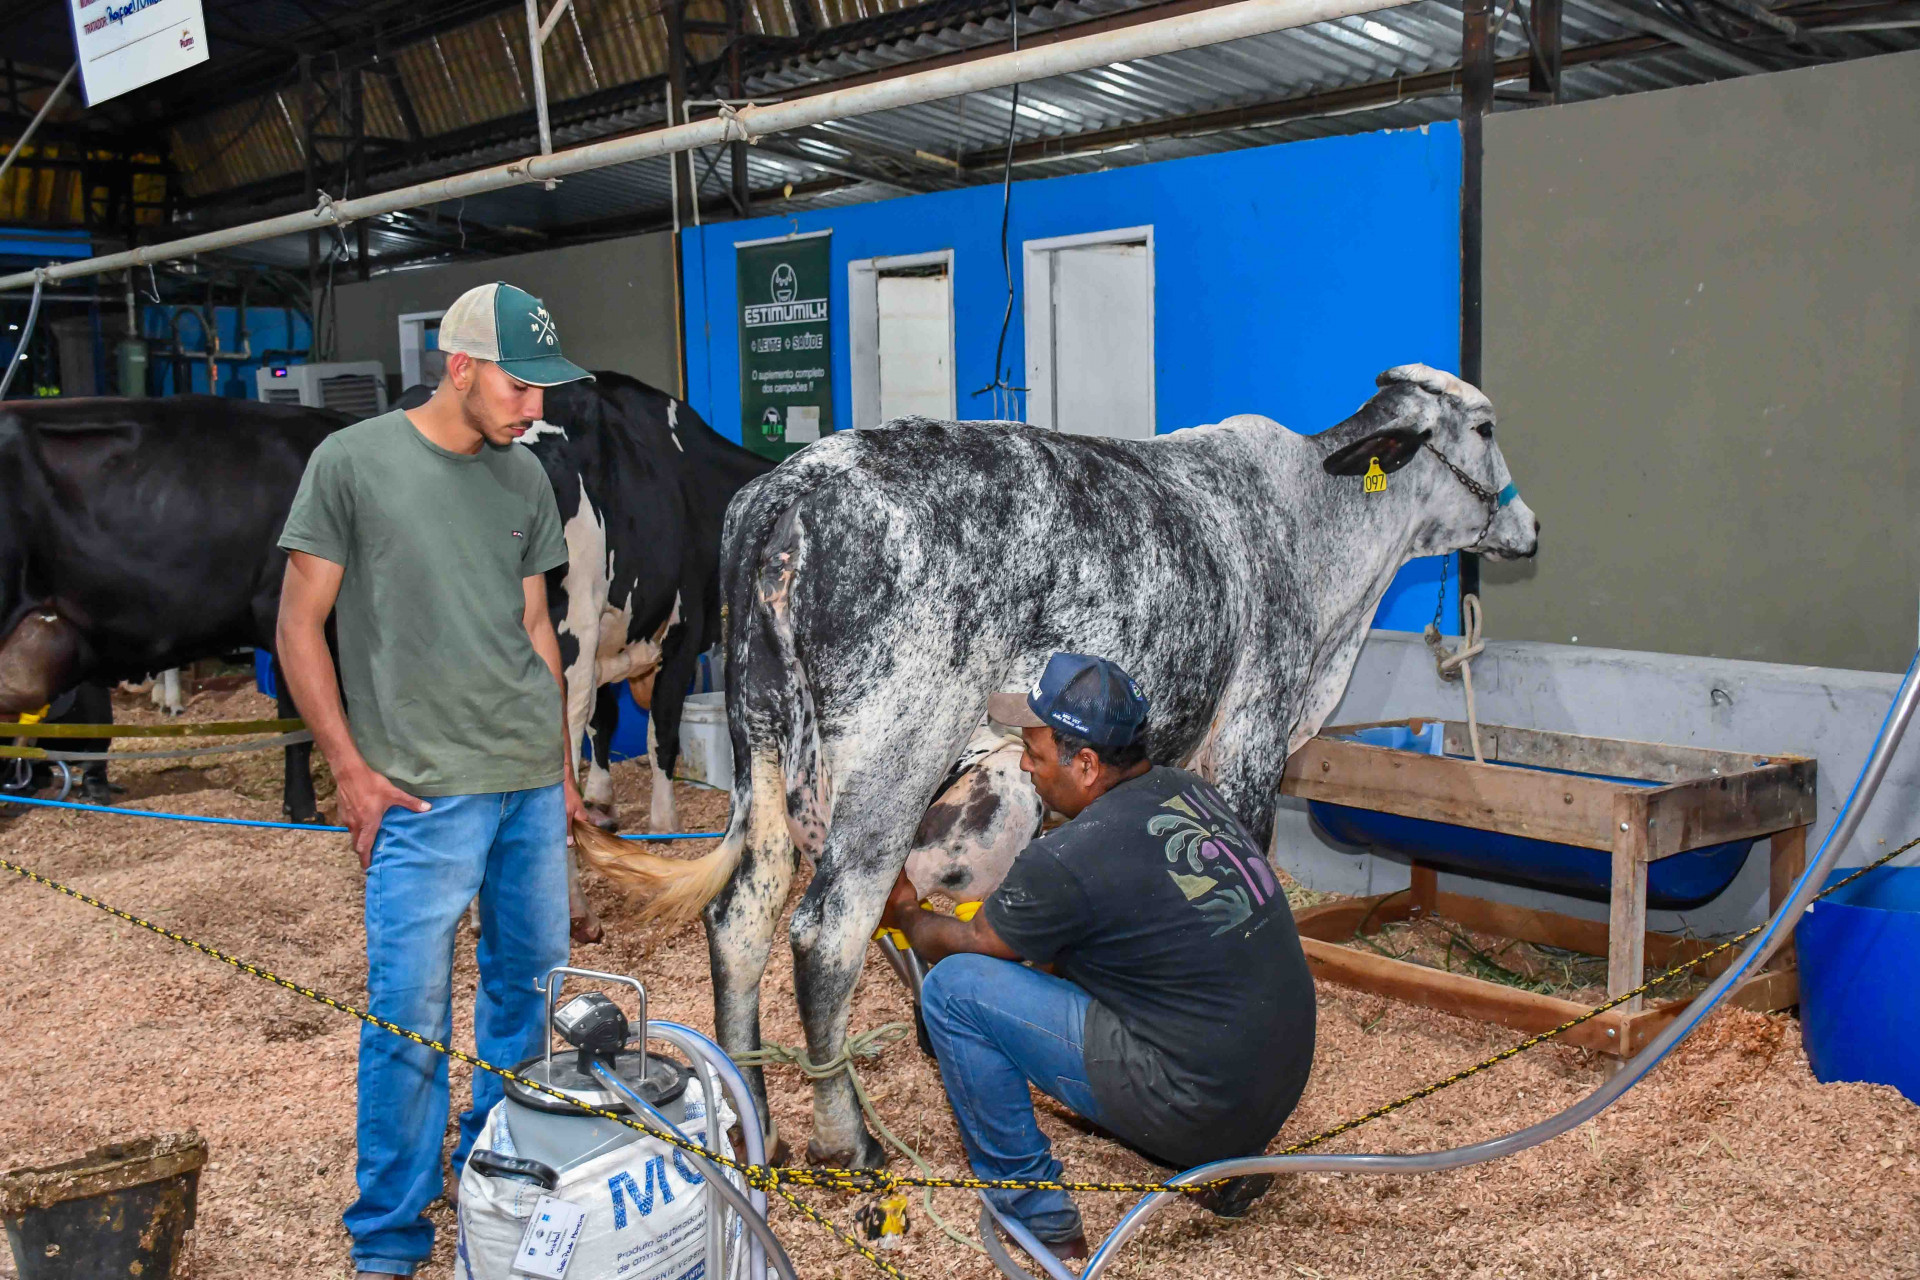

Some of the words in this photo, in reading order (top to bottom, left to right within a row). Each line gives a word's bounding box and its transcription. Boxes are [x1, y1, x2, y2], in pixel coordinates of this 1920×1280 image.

[745, 302, 827, 324] ESTIMUMILK
[757, 336, 782, 353] LEITE
[792, 332, 824, 351] SAÚDE
[1366, 474, 1384, 491] 097
[617, 1240, 654, 1261] Produto
